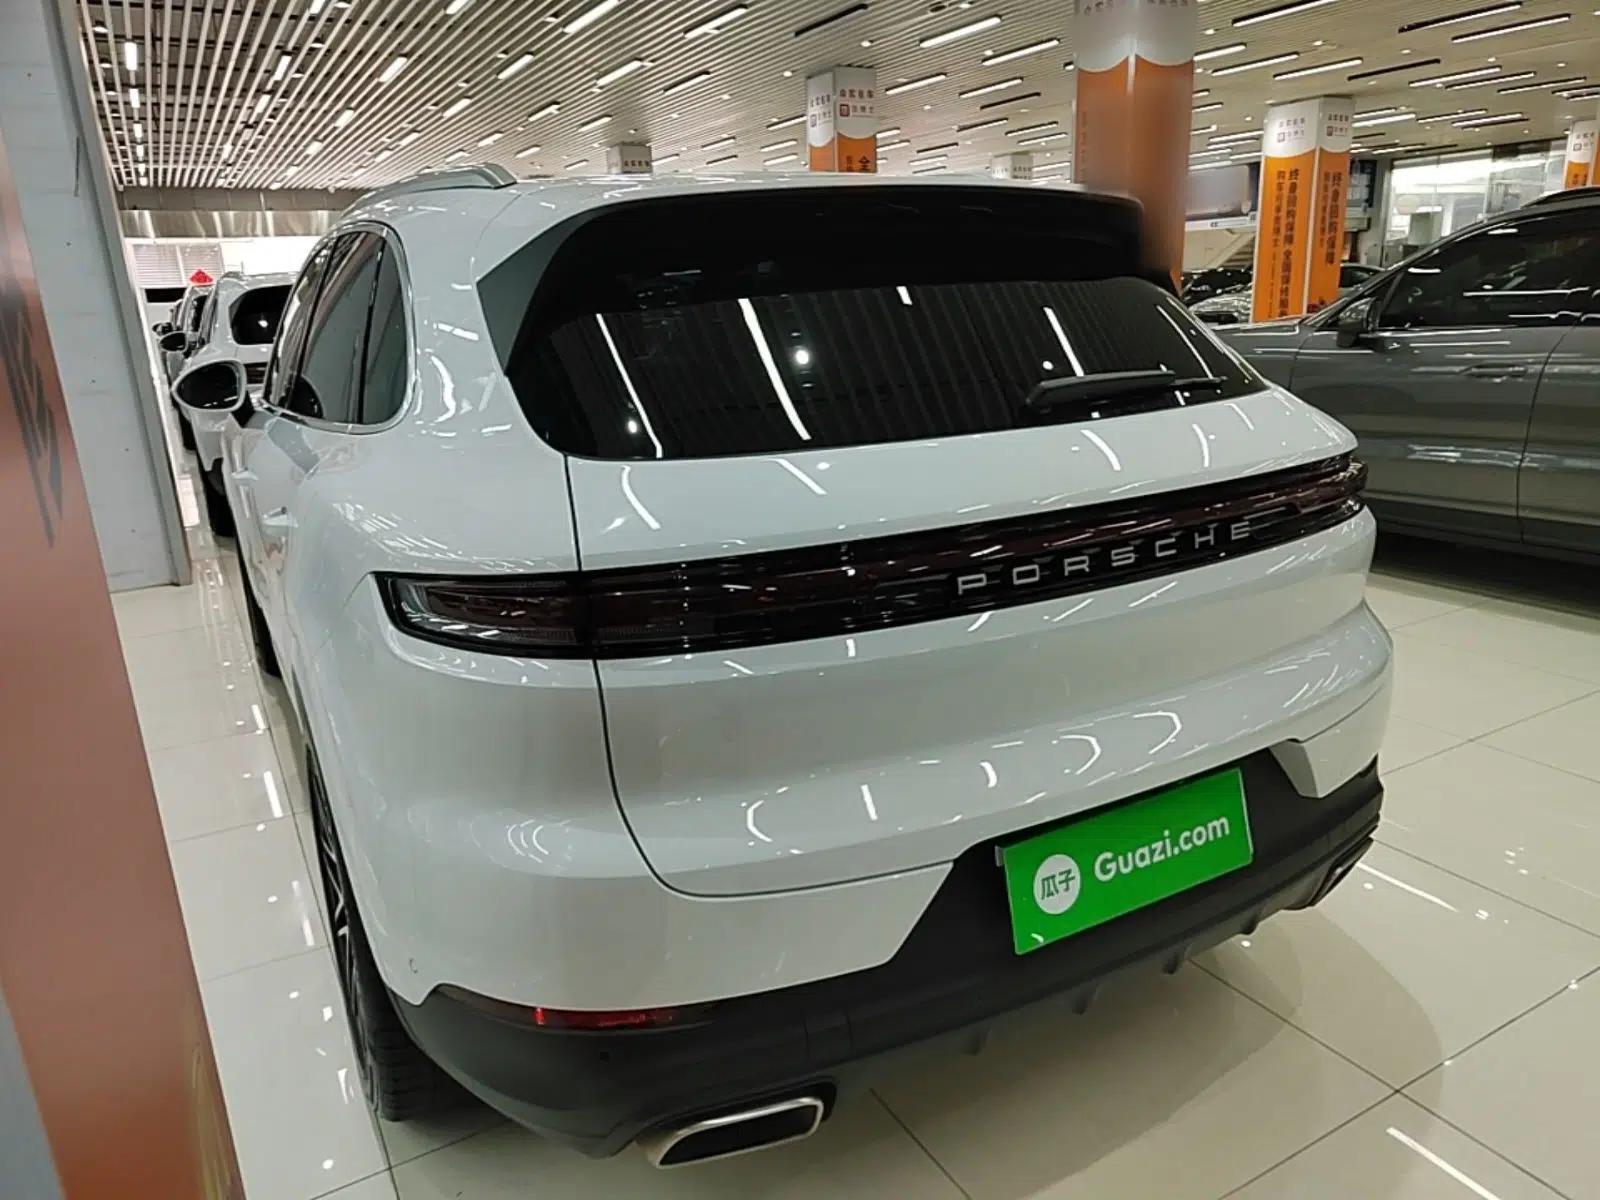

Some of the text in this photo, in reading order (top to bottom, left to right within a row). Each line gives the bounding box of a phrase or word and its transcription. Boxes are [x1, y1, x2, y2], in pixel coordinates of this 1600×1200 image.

[957, 520, 1250, 595] PORSCHE
[1093, 816, 1231, 882] Guazi.com
[1040, 868, 1076, 900] 瓜子
